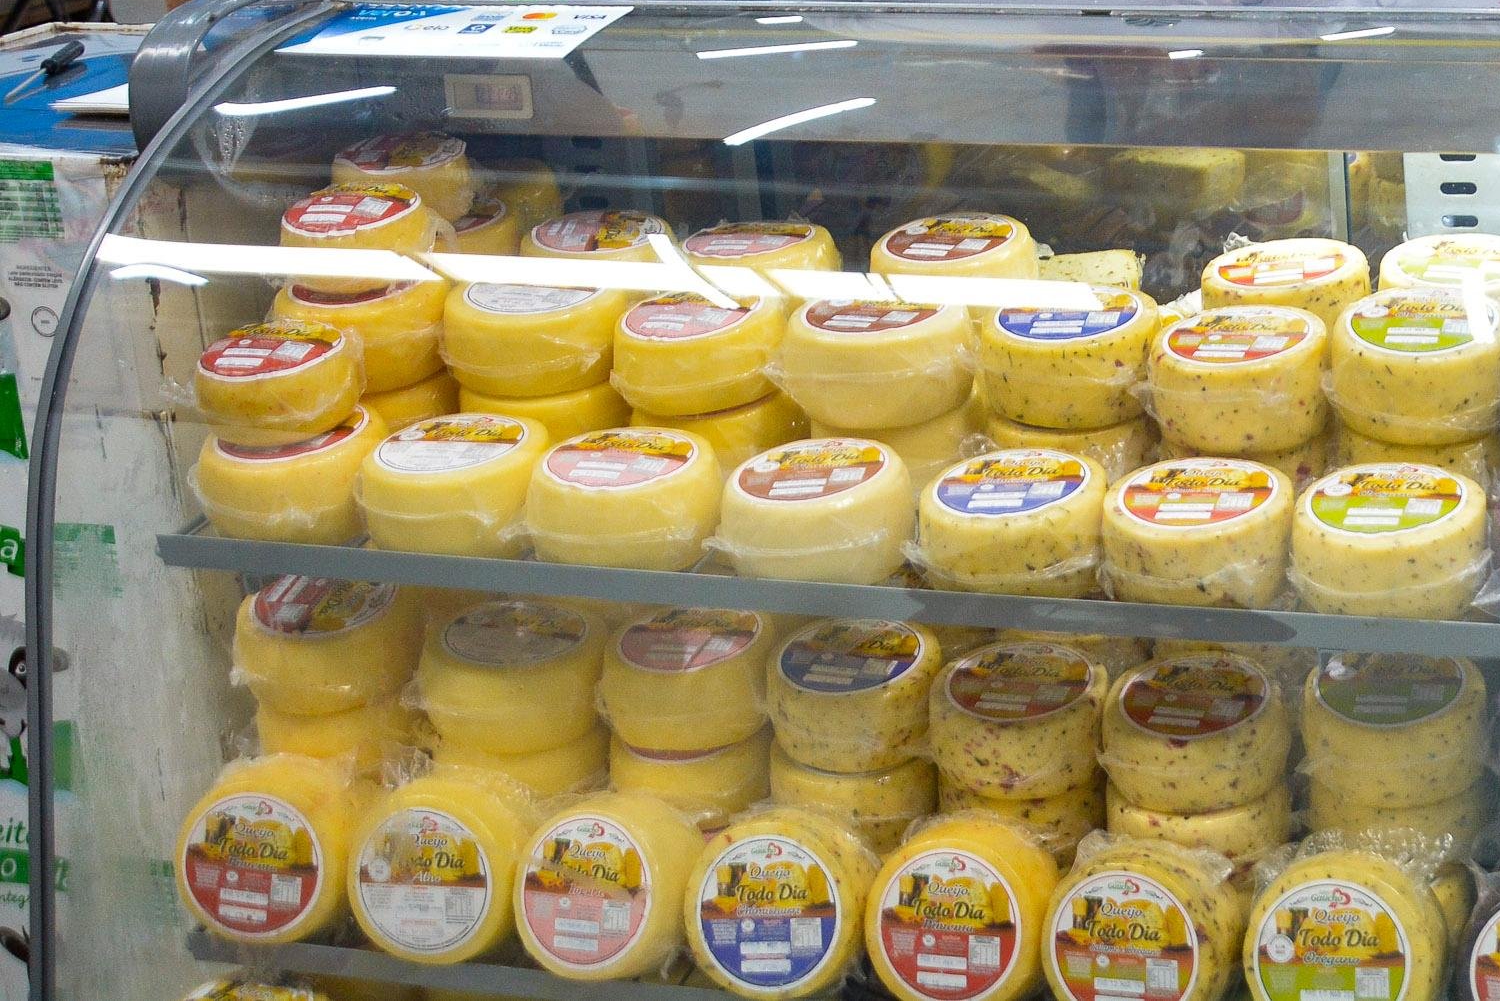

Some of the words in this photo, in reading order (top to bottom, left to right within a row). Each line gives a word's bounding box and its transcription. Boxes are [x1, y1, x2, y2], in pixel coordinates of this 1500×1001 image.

[435, 852, 464, 869] Dia
[592, 864, 620, 883] Dia
[735, 884, 774, 901] Todo
[778, 883, 808, 901] Dia
[927, 880, 970, 898] Queijo
[911, 897, 951, 920] Todo
[953, 901, 985, 920] Dia
[1101, 902, 1146, 920] Queijo
[1314, 908, 1361, 926] Queijo
[1085, 919, 1126, 941] Todo
[1128, 922, 1162, 942] Dia
[1298, 928, 1342, 948] Todo
[1344, 929, 1379, 948] Dia
[1302, 950, 1361, 967] Orégano
